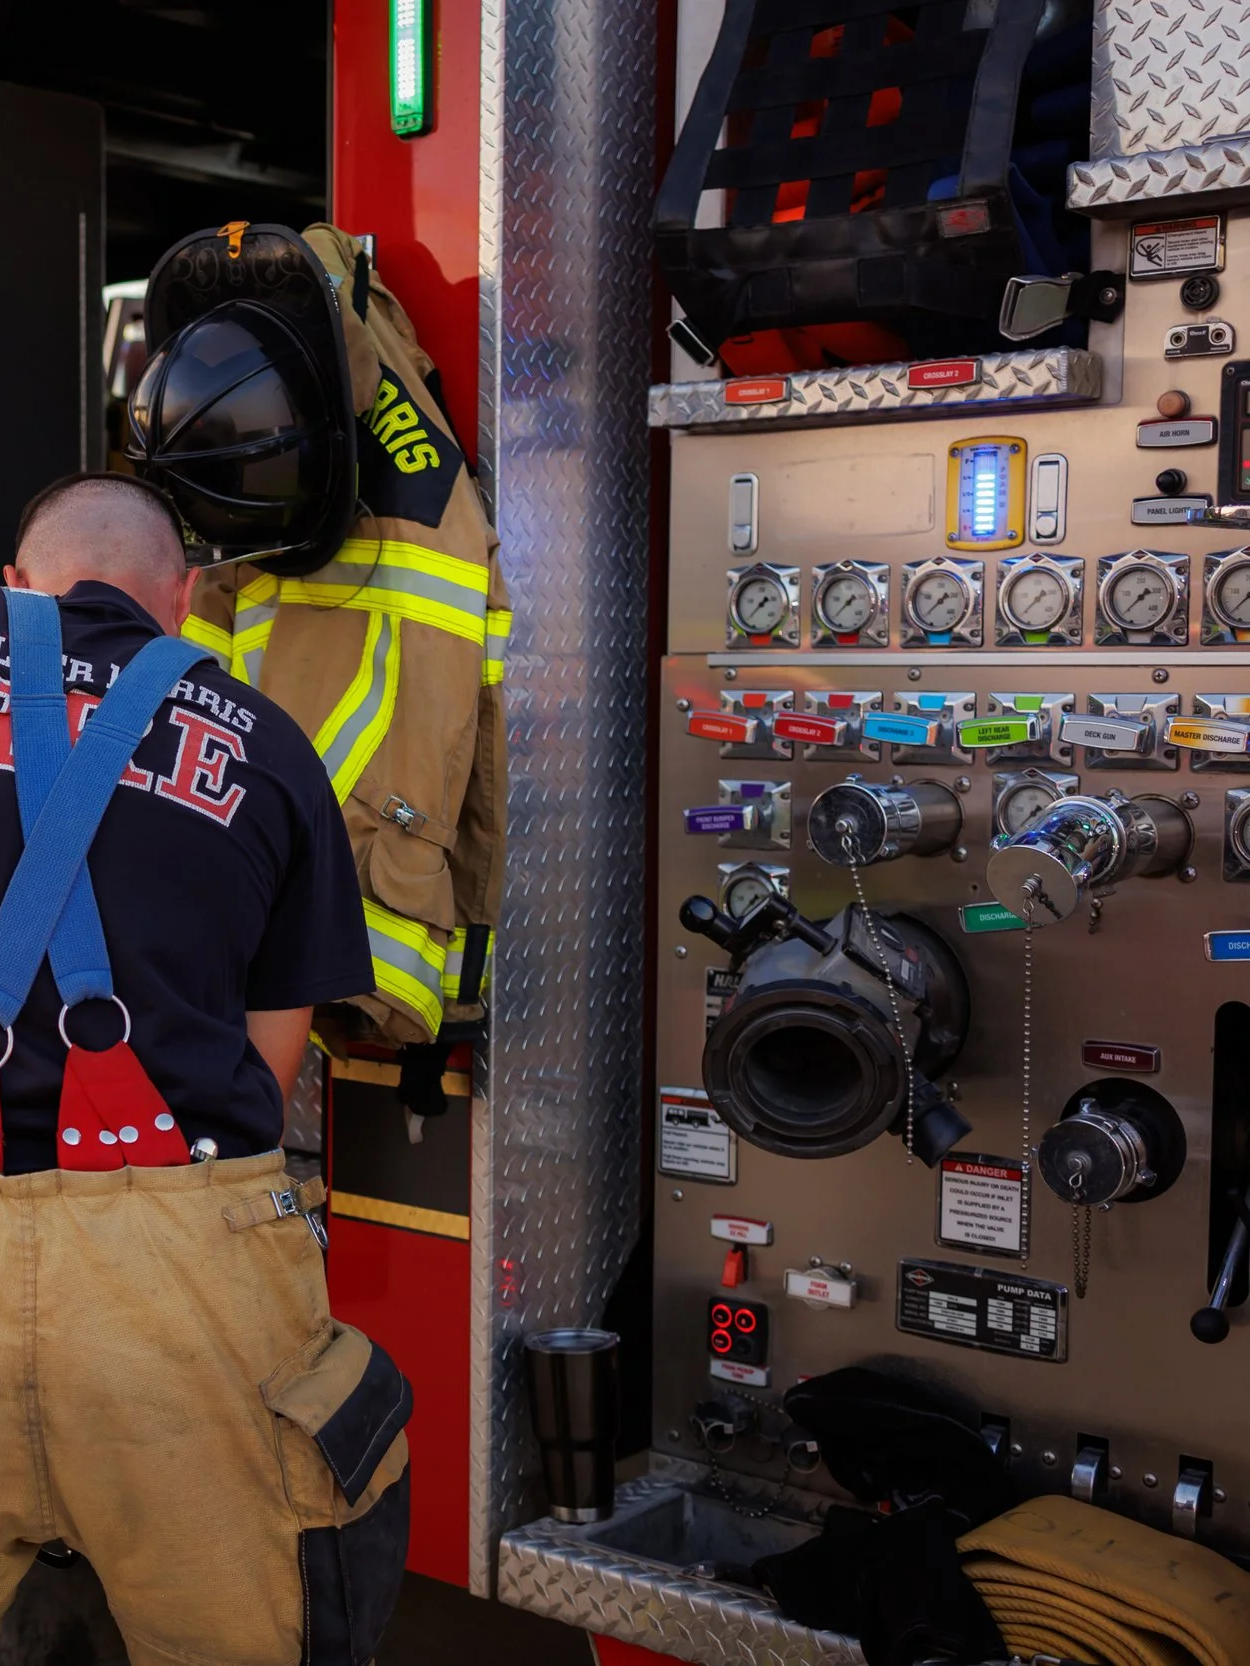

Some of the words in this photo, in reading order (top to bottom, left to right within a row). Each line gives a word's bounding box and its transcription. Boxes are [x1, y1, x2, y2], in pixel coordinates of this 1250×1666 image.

[923, 371, 952, 381] CROSSLAY
[738, 388, 765, 396] CROSSLAY
[1159, 429, 1171, 438] AIR
[1172, 429, 1190, 437] HORN
[1147, 507, 1167, 515] PANEL
[978, 727, 991, 735] LEFT
[993, 725, 1010, 733] REAR
[977, 733, 1011, 742] DISCHARGE
[1084, 730, 1100, 738] DECK
[1101, 732, 1116, 741] GUN
[1174, 730, 1201, 740] MASTER
[1203, 733, 1241, 745] DISCHARGE
[1101, 1053, 1113, 1061] AUX
[1114, 1054, 1137, 1063] INTAKE
[966, 1164, 1008, 1179] DANGER
[949, 1187, 969, 1195] COULD
[970, 1190, 990, 1199] OCCUR
[1000, 1184, 1019, 1193] DEATH
[963, 1200, 991, 1210] SUPPLIED
[949, 1209, 988, 1219] PRESSURIZED
[989, 1214, 1012, 1224] SOURCE
[987, 1224, 1004, 1233] VALVE
[807, 1288, 830, 1298] OUTLET
[997, 1283, 1025, 1296] PUMP
[1026, 1288, 1052, 1301] DATA
